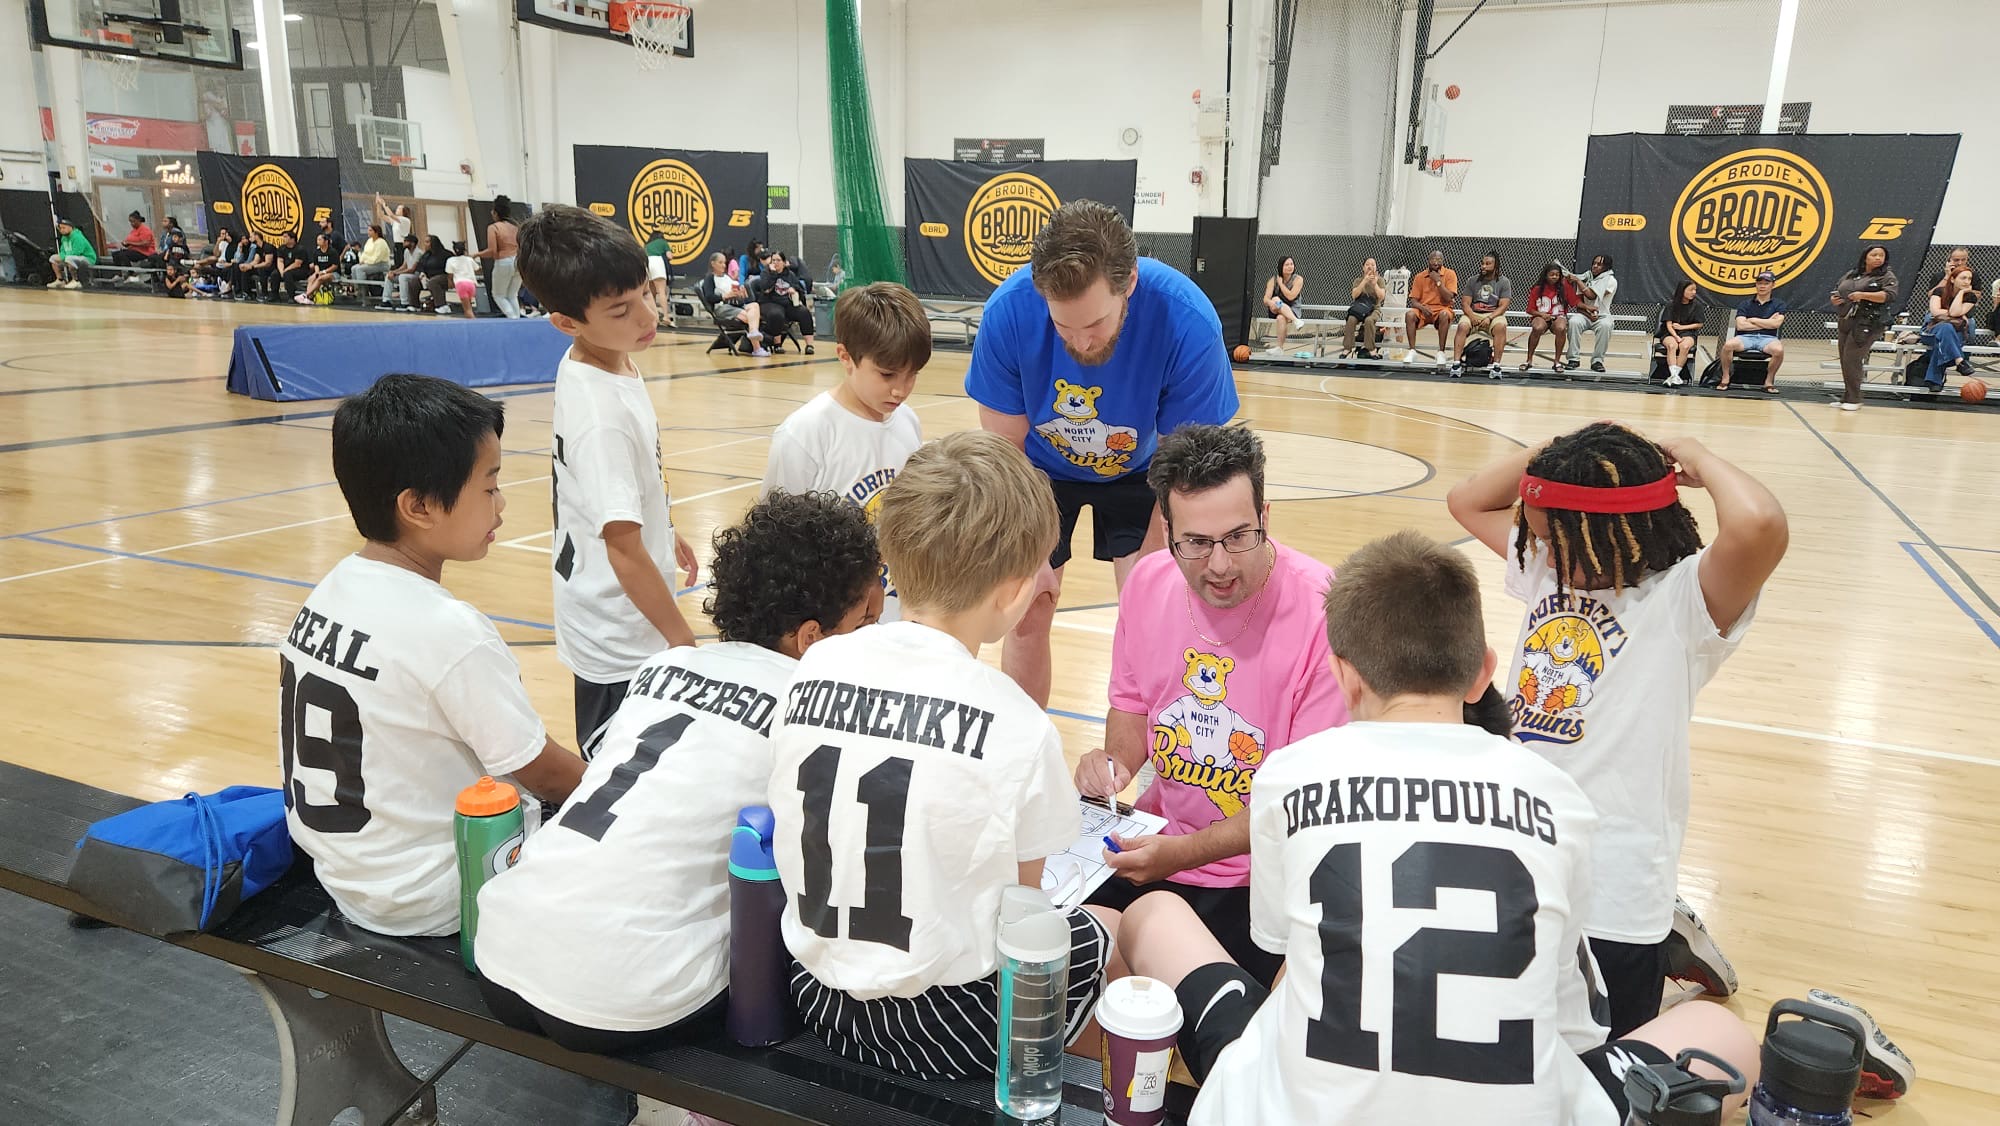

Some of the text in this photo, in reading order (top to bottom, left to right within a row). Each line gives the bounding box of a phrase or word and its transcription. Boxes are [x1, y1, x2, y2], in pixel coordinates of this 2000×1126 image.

[653, 169, 687, 183] BRODIE
[1728, 163, 1792, 182] BRODIE
[252, 189, 294, 219] BRODIE
[995, 184, 1036, 198] BRODIE
[642, 188, 699, 224] BRODIE
[1695, 189, 1808, 237] BRODIE
[1616, 217, 1637, 227] BRL
[1710, 228, 1784, 256] Summer
[1392, 280, 1406, 295] 12
[1064, 427, 1096, 435] NORTH
[1540, 675, 1558, 687] CITY
[1542, 665, 1564, 680] NORTH
[784, 679, 995, 760] CHORNENKYI
[1190, 710, 1219, 726] NORTH
[1508, 694, 1585, 738] Bruins
[280, 652, 372, 833] 19
[1195, 725, 1215, 739] CITY
[1152, 724, 1257, 796] Bruins
[559, 713, 696, 842] 1
[1283, 776, 1558, 846] DRAKOPOULOS
[797, 744, 914, 953] 11
[1305, 841, 1540, 1085] 12
